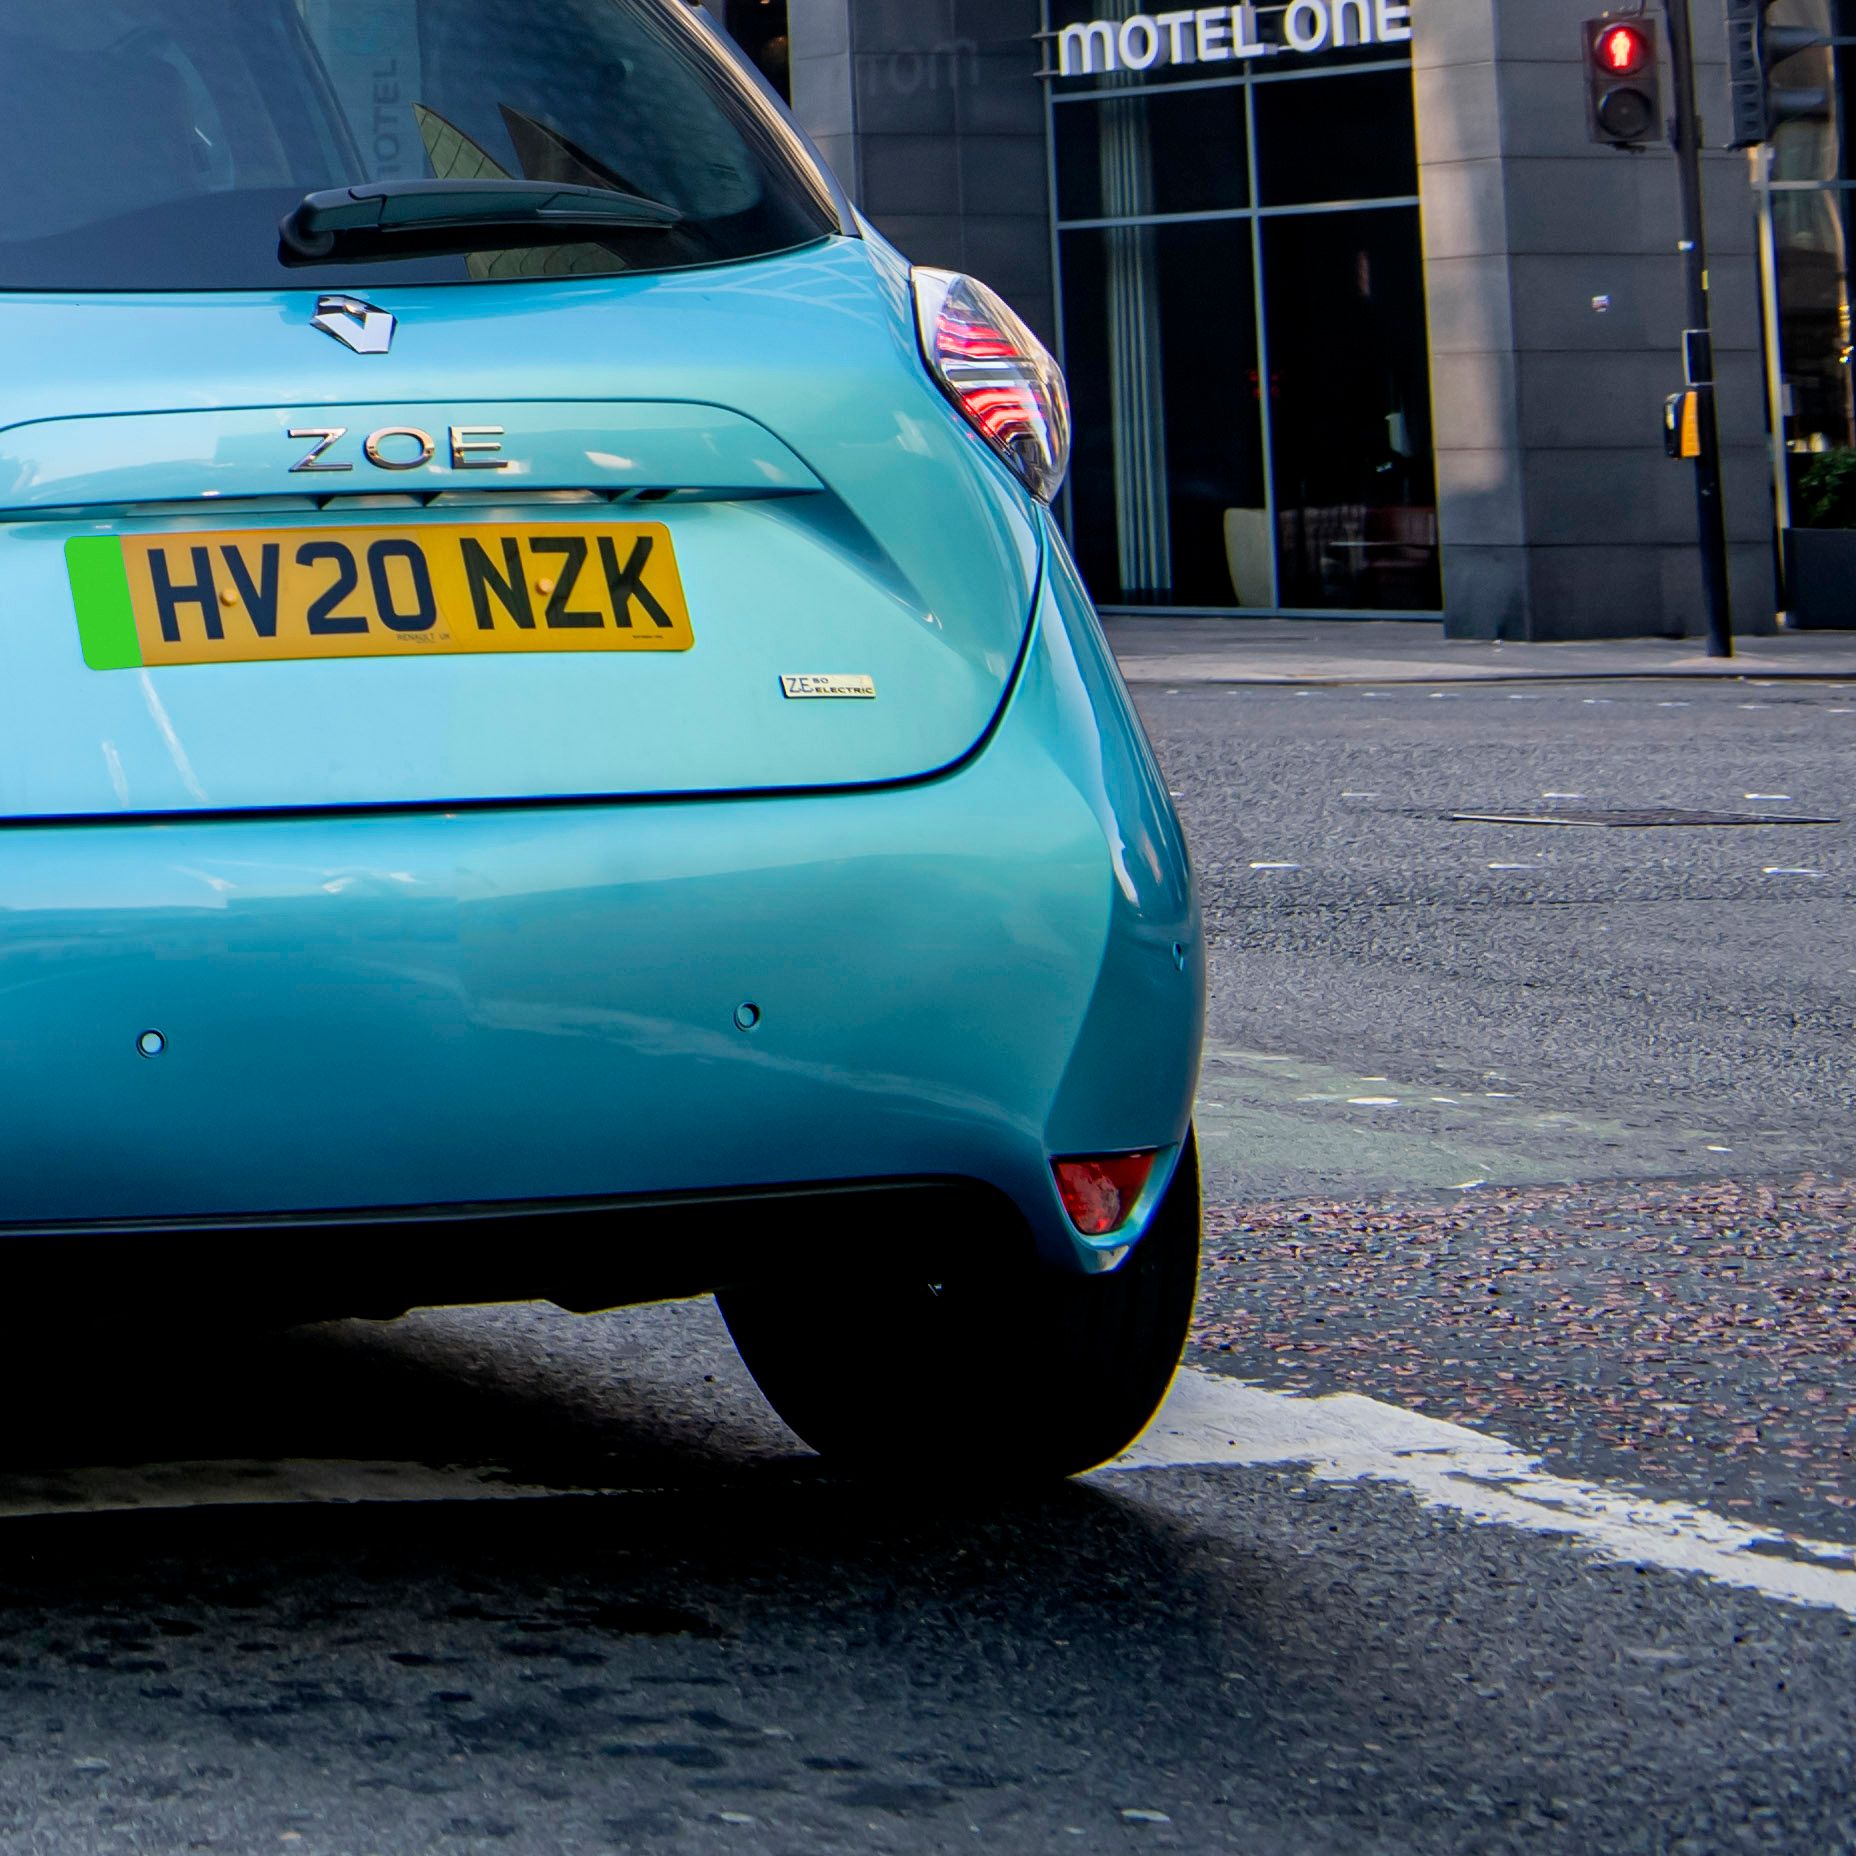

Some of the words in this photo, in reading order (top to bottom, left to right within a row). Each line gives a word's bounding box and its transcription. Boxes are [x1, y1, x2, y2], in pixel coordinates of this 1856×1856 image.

[289, 425, 509, 472] ZOE
[147, 540, 438, 643] HV20
[460, 536, 674, 629] NZK
[786, 677, 813, 693] ZE
[814, 686, 874, 694] ELECTRIC
